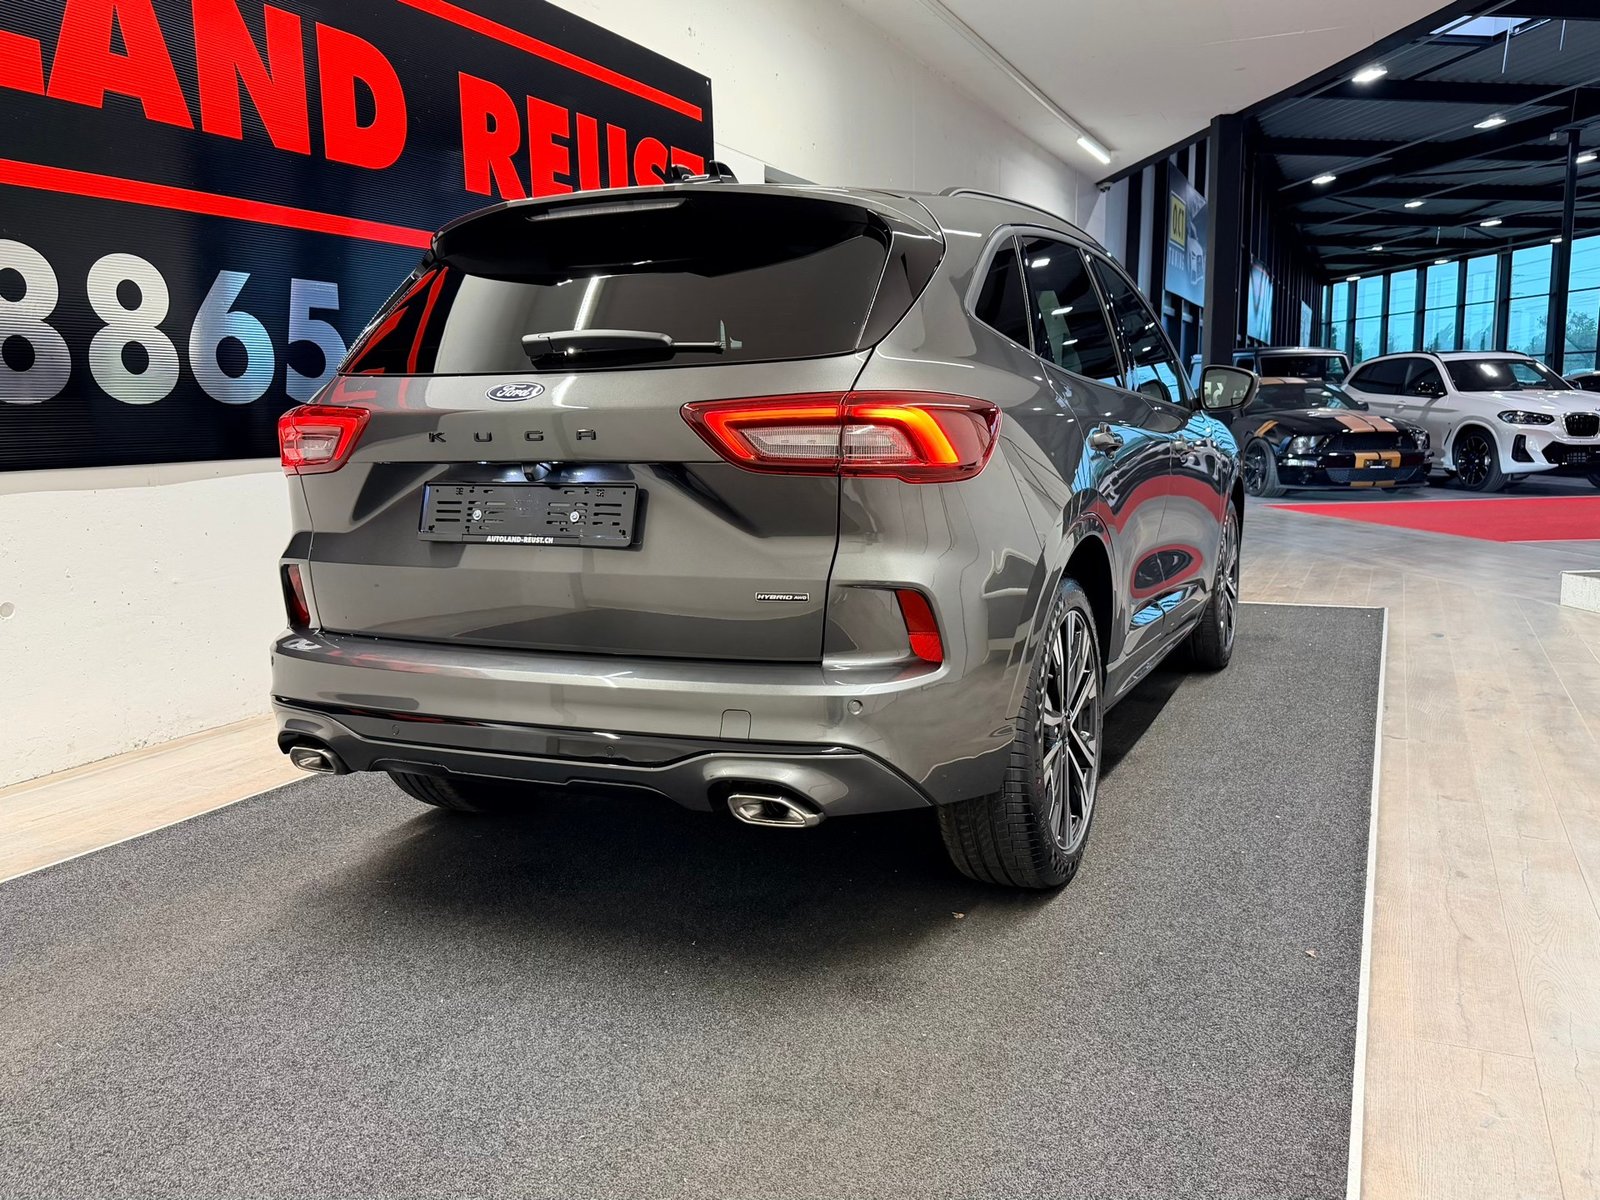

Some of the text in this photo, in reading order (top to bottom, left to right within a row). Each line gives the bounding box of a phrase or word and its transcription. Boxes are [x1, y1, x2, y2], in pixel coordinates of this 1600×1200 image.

[0, 238, 347, 405] 8865
[493, 384, 539, 398] Ford
[428, 428, 597, 443] KUGA
[486, 535, 554, 544] AUTOLAND-REUST.CH
